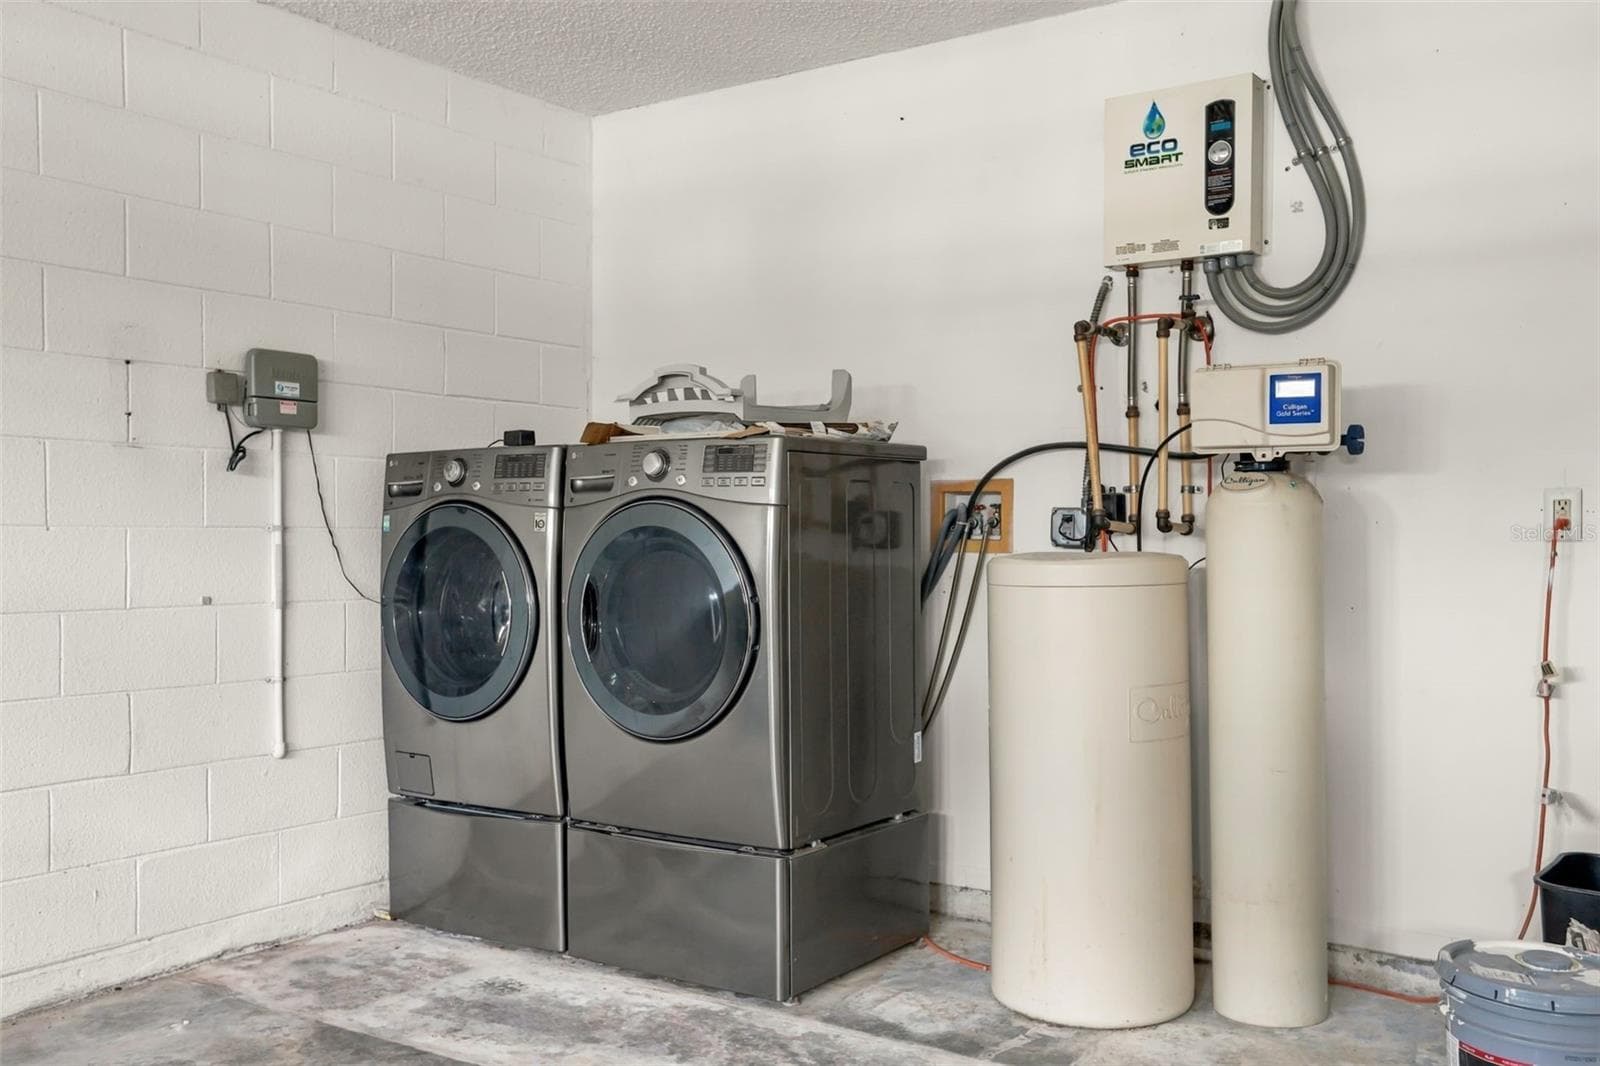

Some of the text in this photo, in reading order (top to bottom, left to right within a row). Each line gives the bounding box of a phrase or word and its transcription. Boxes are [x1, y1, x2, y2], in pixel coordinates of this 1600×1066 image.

[1130, 138, 1178, 157] eco
[1282, 403, 1308, 411] Culligan
[1224, 476, 1265, 486] Culligan
